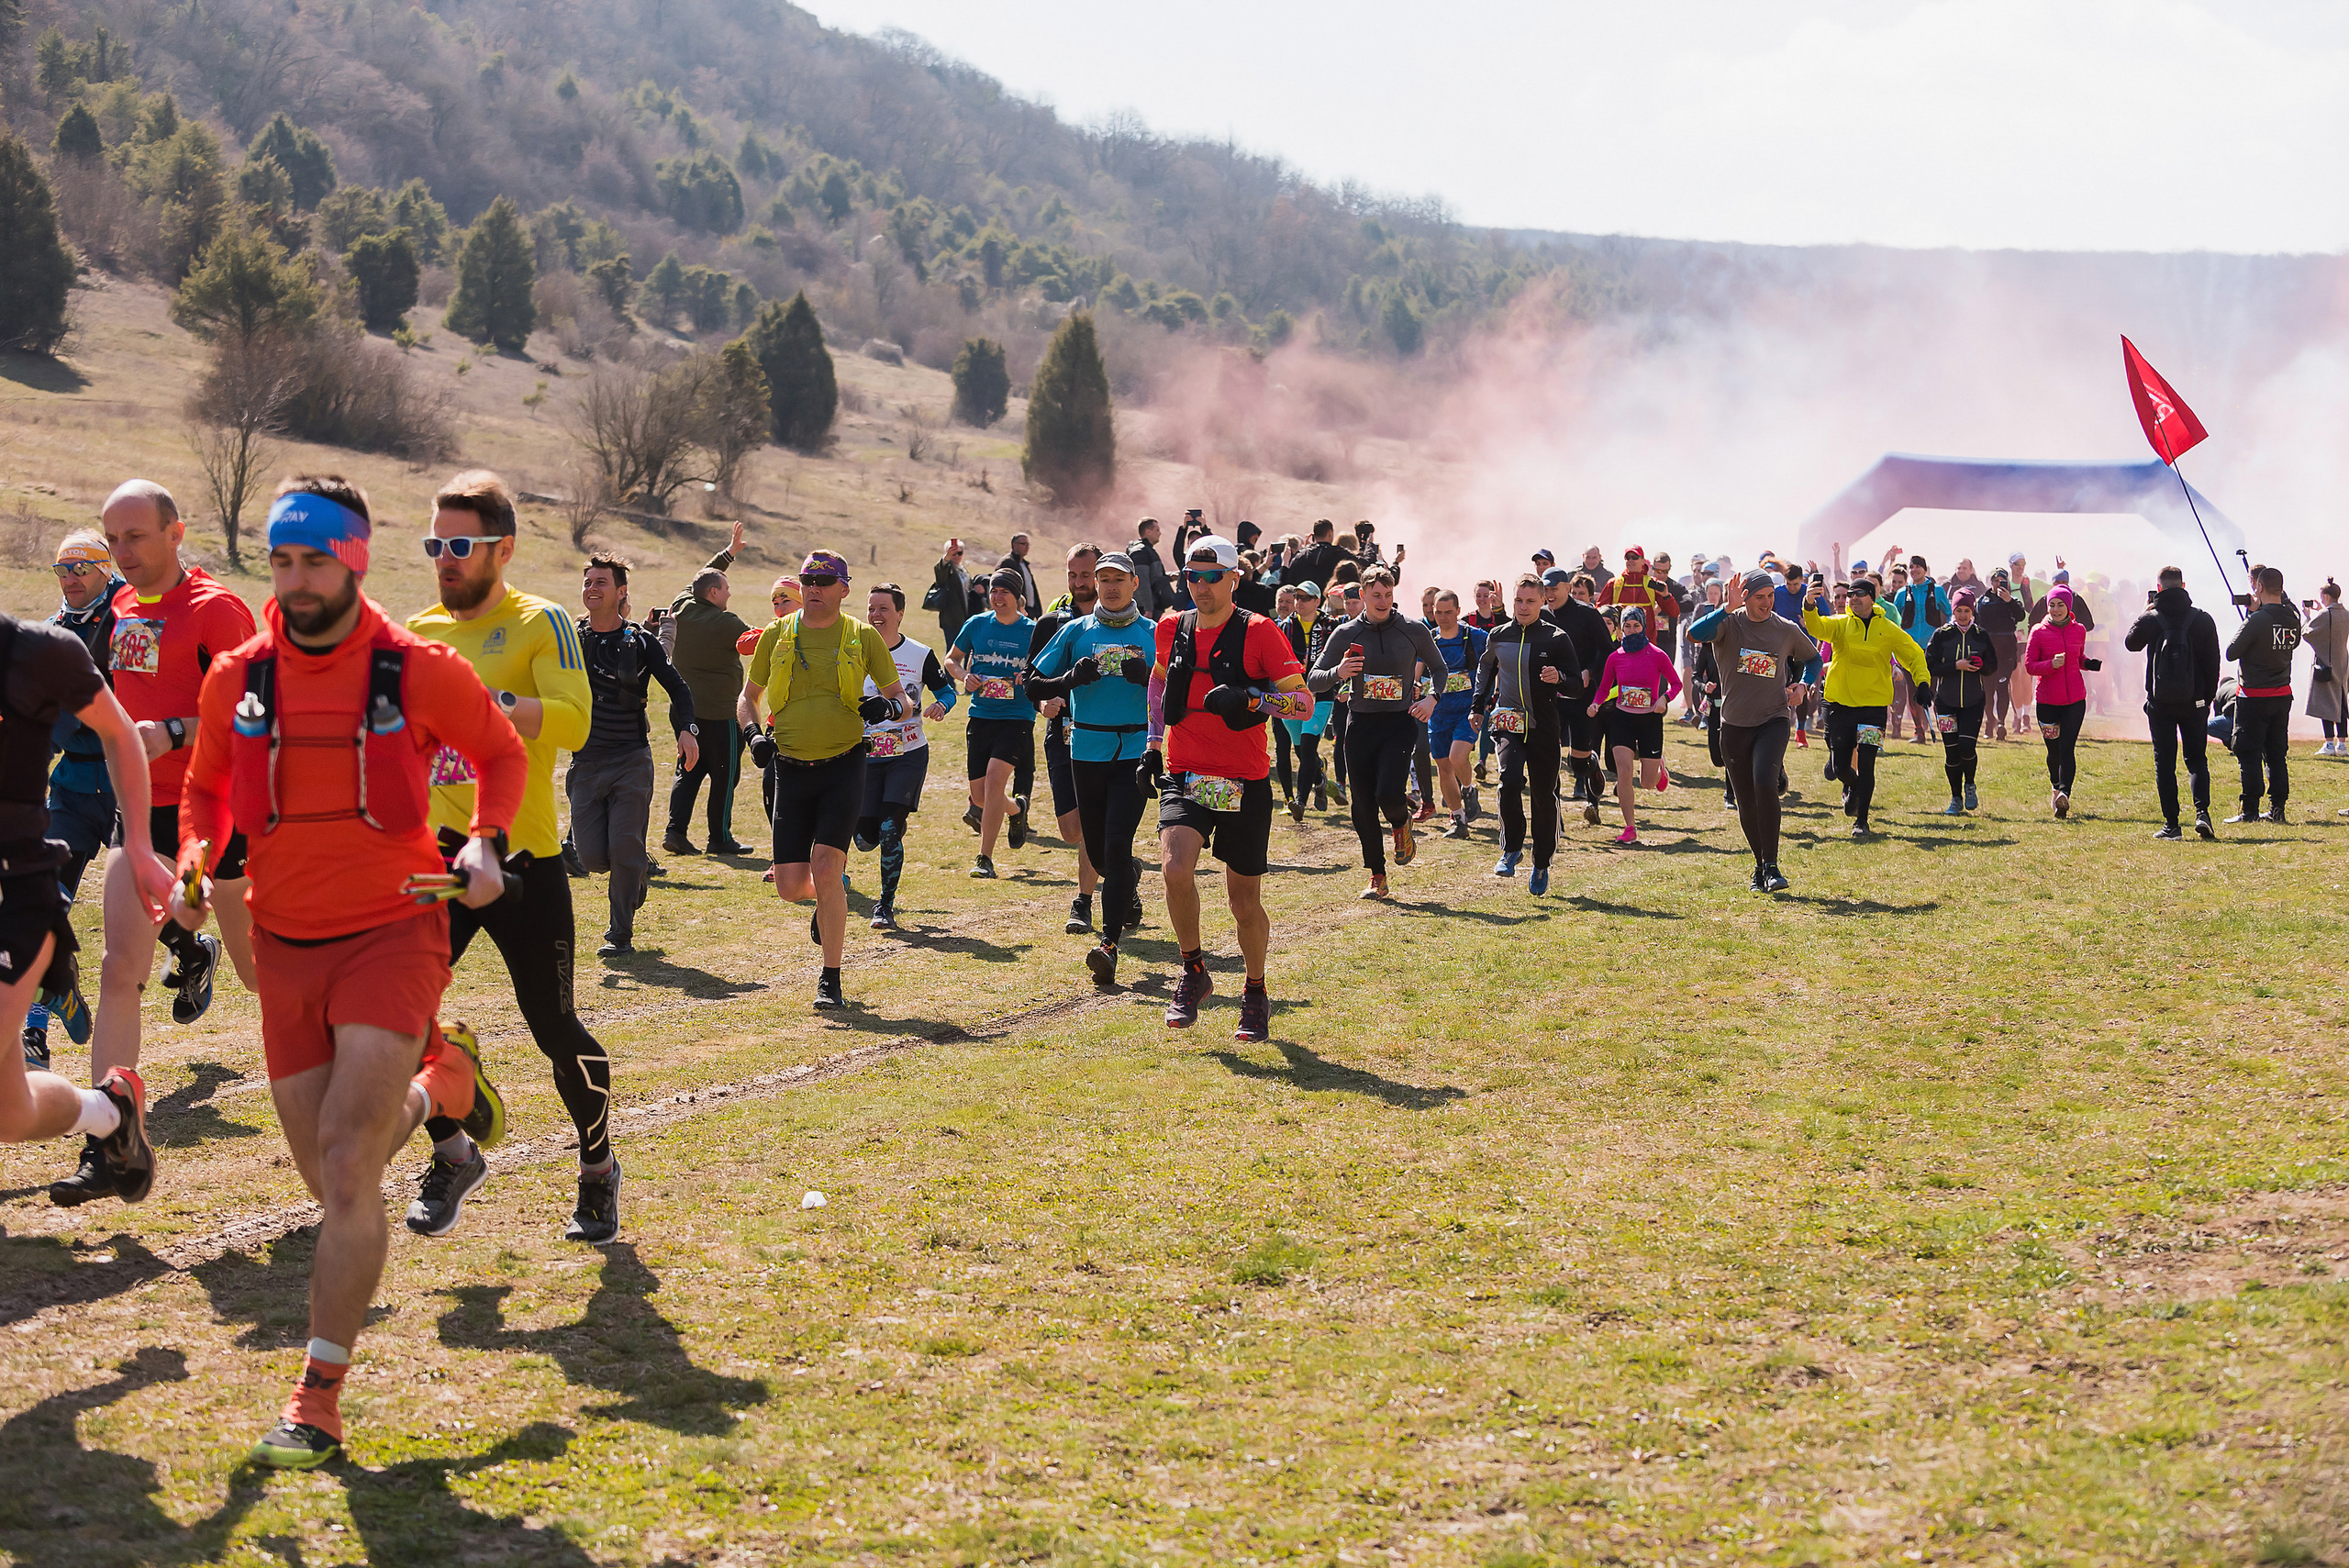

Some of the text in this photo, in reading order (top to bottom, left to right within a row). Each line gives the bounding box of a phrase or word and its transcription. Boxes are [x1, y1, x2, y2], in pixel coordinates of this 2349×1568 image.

[2273, 628, 2297, 645] KFS
[118, 633, 149, 667] 105
[1747, 657, 1769, 674] 169
[985, 682, 1006, 698] 236
[1372, 682, 1395, 698] 114
[1496, 714, 1516, 731] 113
[869, 737, 894, 756] 58
[1196, 783, 1229, 809] 316
